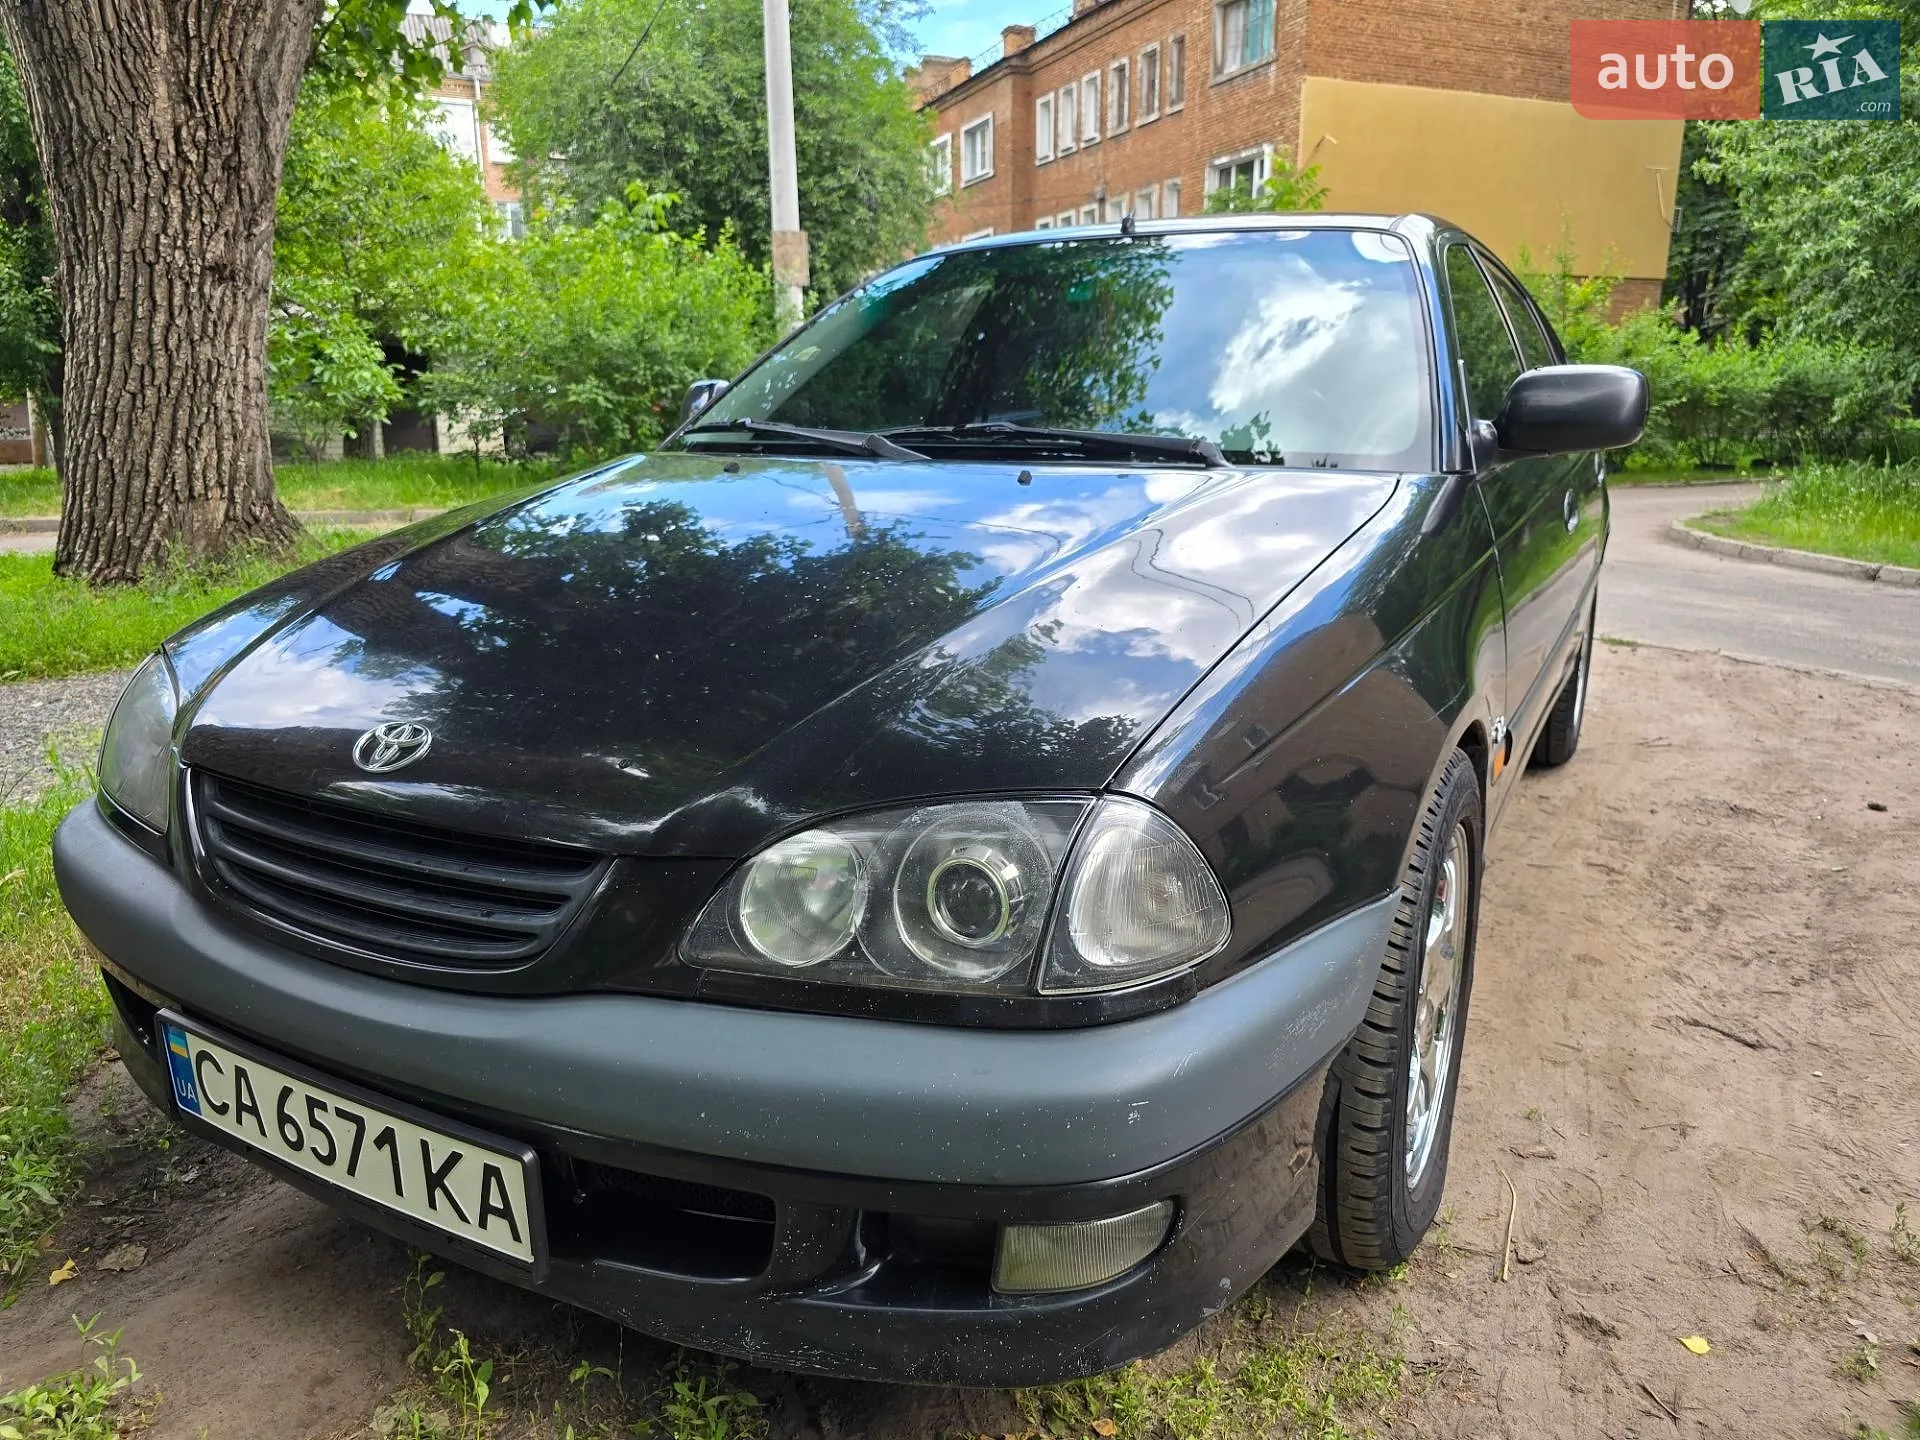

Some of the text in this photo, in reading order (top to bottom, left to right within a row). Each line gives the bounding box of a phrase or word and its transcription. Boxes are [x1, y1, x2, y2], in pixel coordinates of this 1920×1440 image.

[176, 1077, 197, 1103] UA
[195, 1050, 523, 1244] CA 6571 KA
